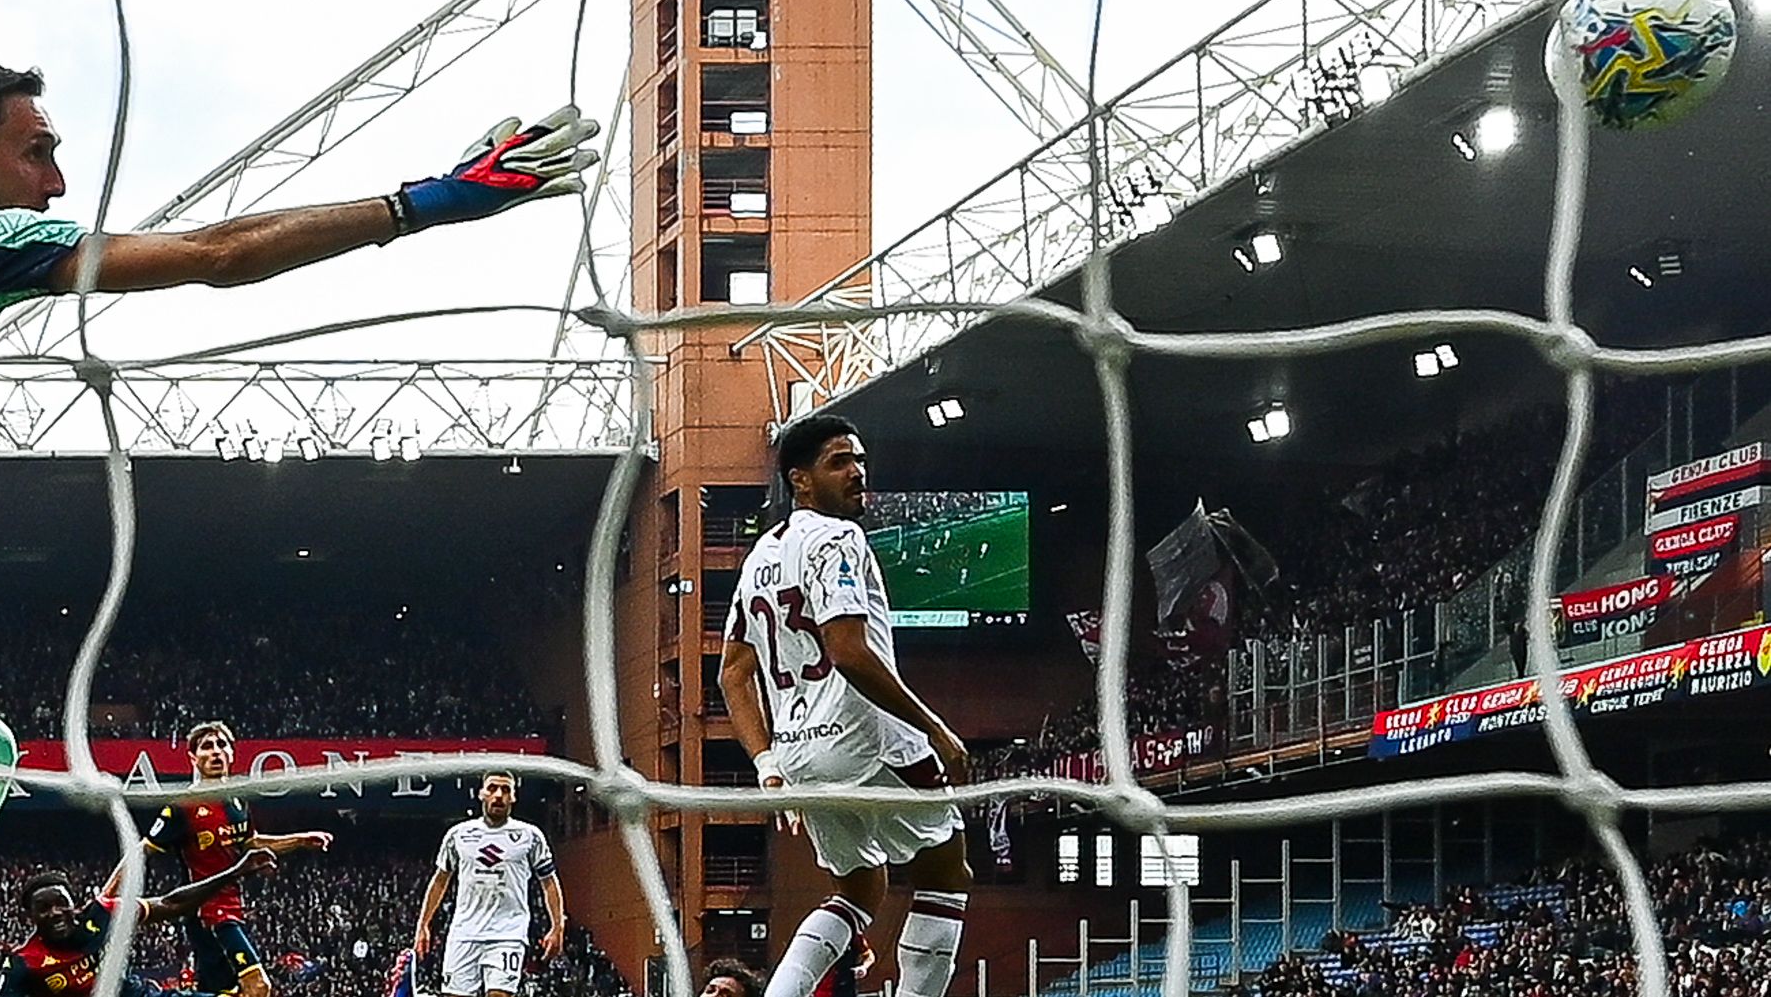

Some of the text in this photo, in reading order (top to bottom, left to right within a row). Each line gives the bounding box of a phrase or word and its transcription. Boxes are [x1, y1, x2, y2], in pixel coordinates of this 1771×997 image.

[1671, 445, 1759, 484] GENOA CLUB
[1680, 493, 1743, 522] FIRENZE
[1654, 522, 1734, 552] GENOA CLUB
[1600, 579, 1659, 613] HONG
[1601, 606, 1658, 639] KONG
[750, 585, 834, 690] 23
[1699, 635, 1744, 656] GENOA
[1599, 655, 1673, 684] GENOA CLUB
[1689, 650, 1752, 676] CASARZA
[1690, 670, 1753, 695] MAURIZIO
[1386, 695, 1478, 730] GENOA CLUB
[1482, 688, 1523, 710] GENOA
[1478, 704, 1550, 733] MONTEROSS
[1399, 728, 1452, 754] LEVANTO
[501, 951, 520, 972] 10
